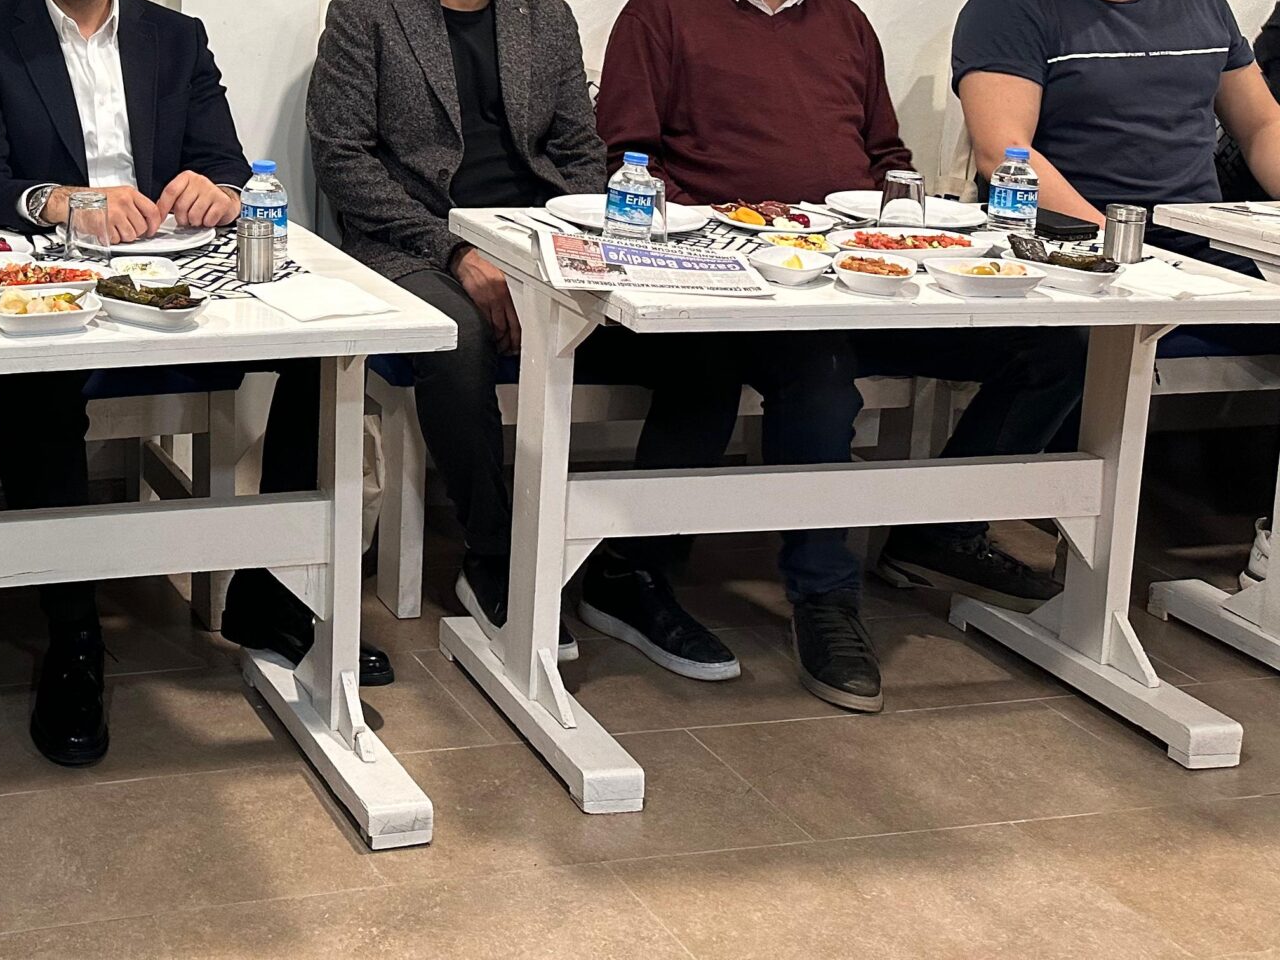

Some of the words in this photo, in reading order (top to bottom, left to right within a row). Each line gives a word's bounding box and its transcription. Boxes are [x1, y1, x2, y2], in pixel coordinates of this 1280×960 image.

[625, 194, 651, 206] Erikli
[256, 207, 282, 219] Erikli
[608, 250, 679, 269] Belediye
[682, 260, 740, 271] Gazete
